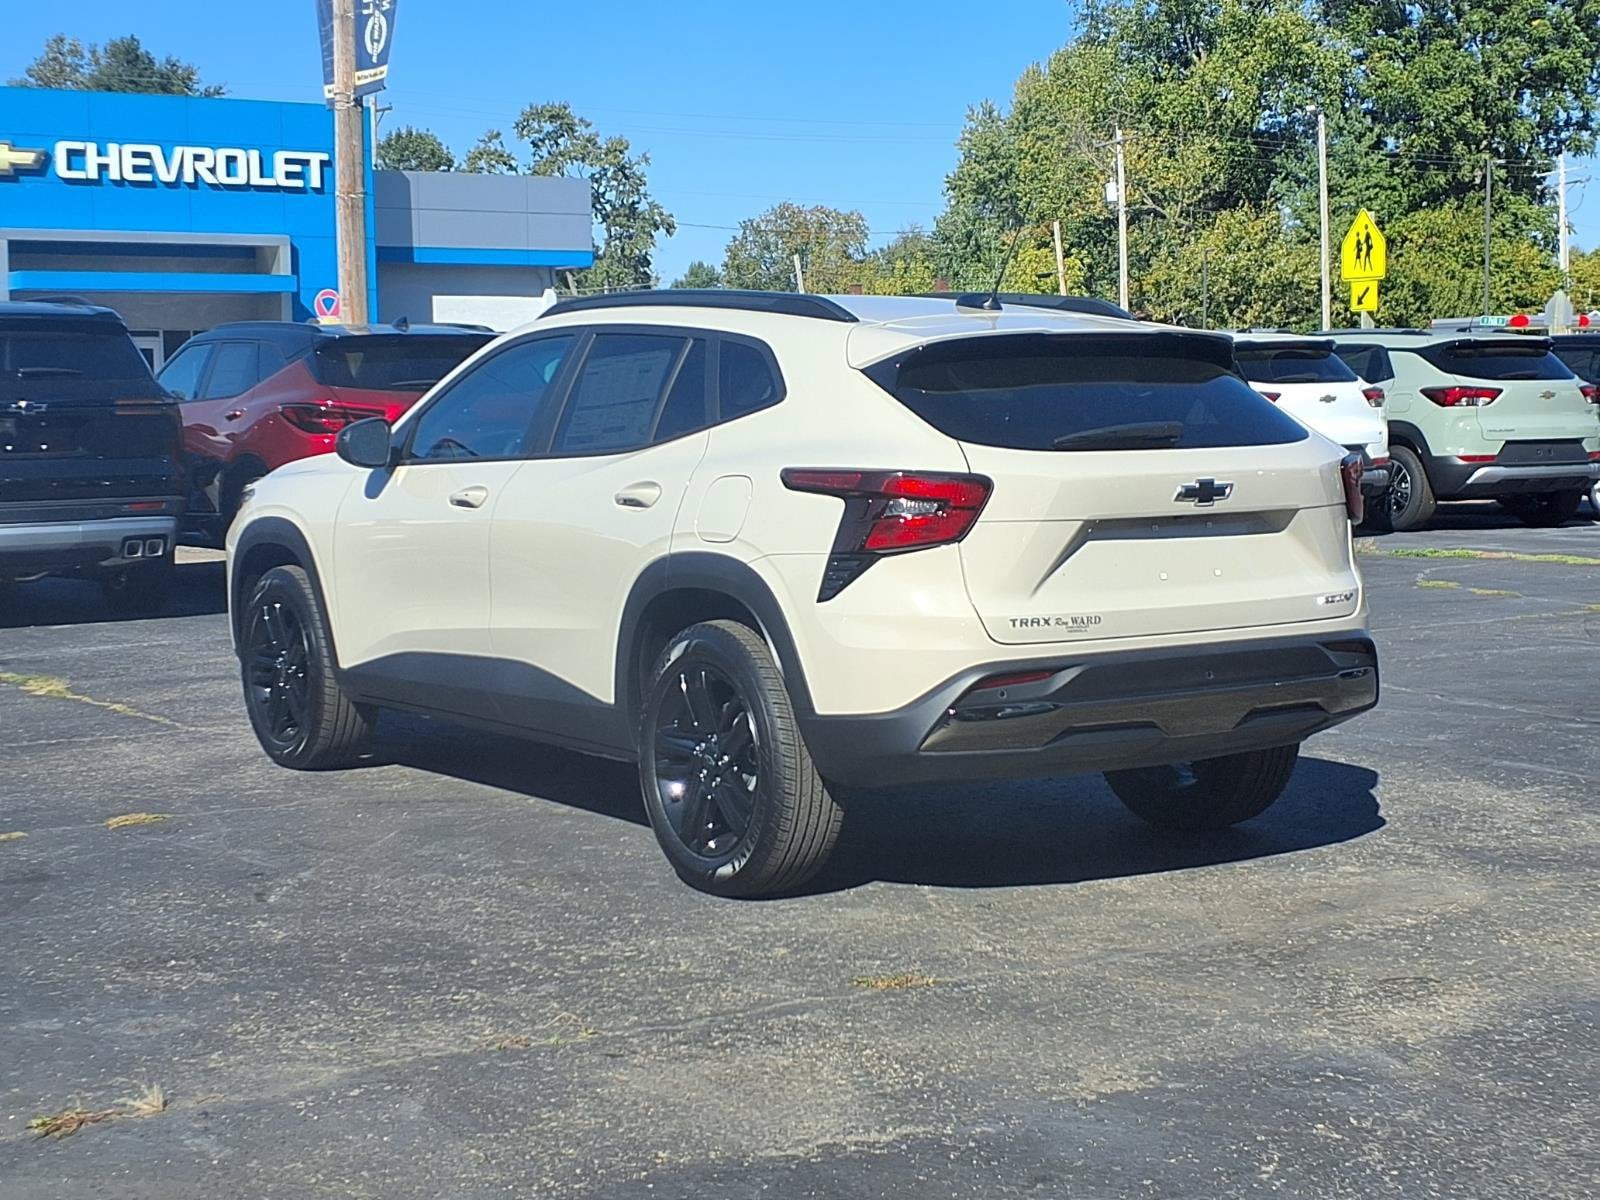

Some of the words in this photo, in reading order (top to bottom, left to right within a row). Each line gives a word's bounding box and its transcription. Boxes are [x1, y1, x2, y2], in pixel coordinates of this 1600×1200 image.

[54, 140, 330, 188] CHEVROLET
[1009, 617, 1051, 628] TRAX
[1071, 616, 1102, 626] WARD
